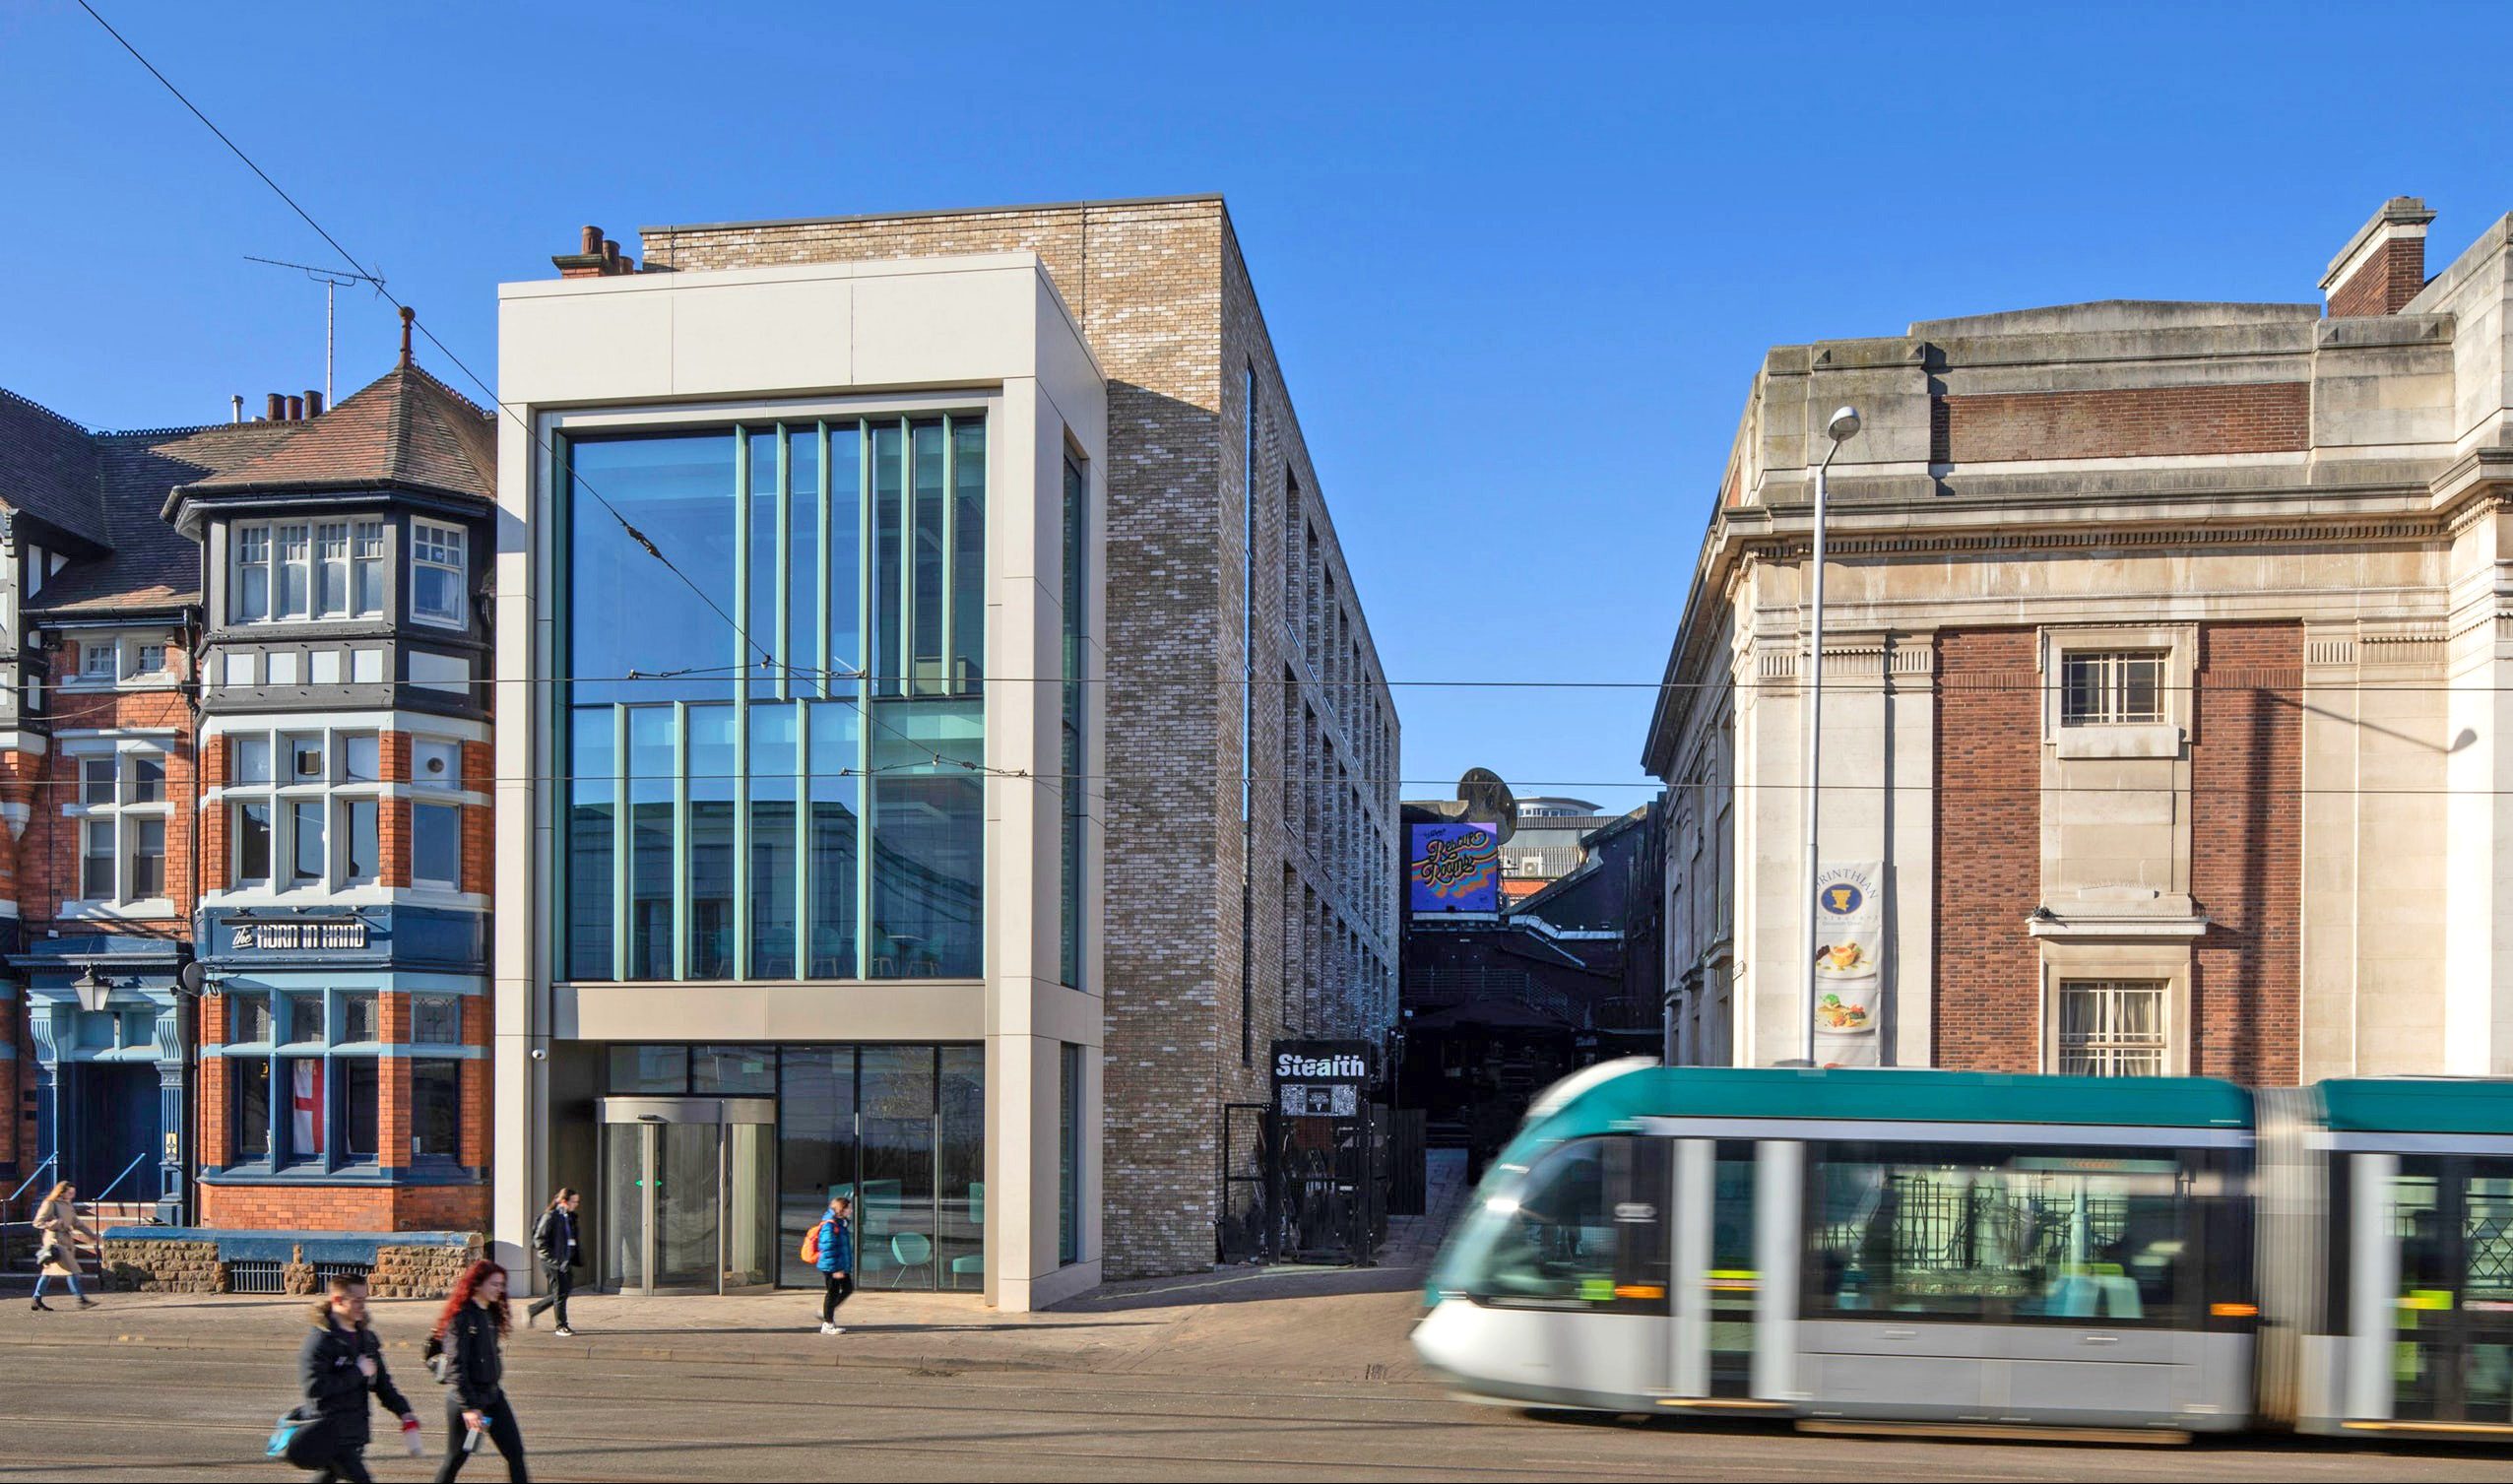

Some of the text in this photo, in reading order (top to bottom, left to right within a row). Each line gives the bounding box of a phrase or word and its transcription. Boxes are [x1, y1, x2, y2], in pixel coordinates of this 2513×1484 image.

[1426, 830, 1487, 863] Rescue
[1421, 855, 1476, 884] Rooms
[1817, 868, 1879, 898] RINTHIAN
[257, 924, 296, 948] HORN
[302, 924, 318, 948] IN
[322, 924, 364, 948] HAND
[1276, 1054, 1365, 1076] Stealth
